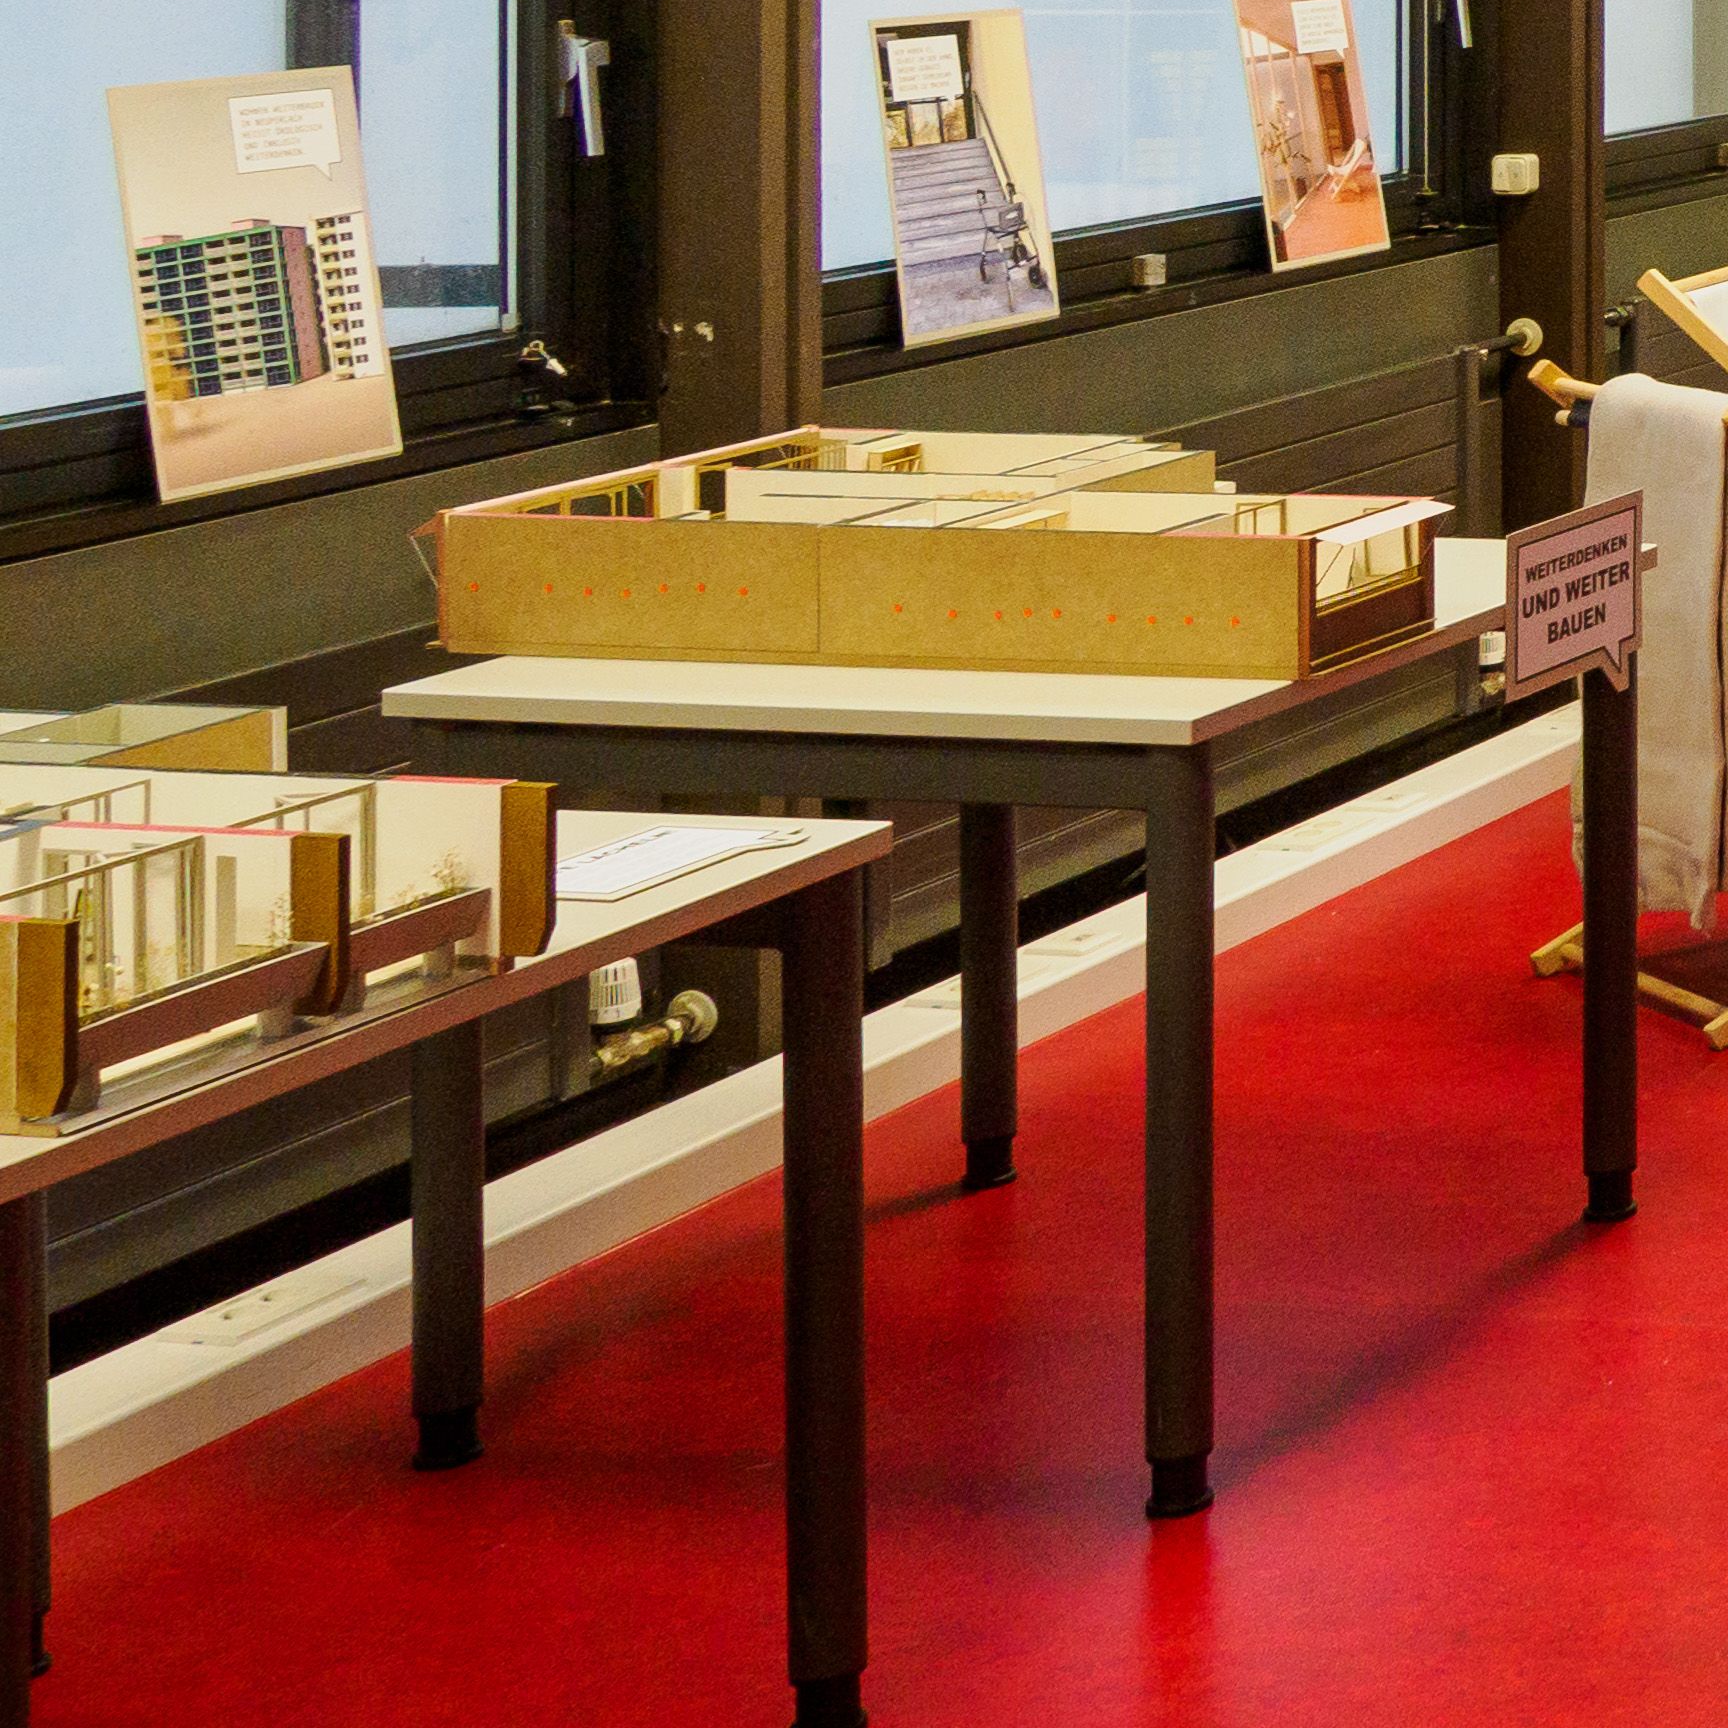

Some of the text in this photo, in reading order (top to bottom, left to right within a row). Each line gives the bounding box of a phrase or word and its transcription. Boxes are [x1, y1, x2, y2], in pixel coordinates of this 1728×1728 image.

[1525, 534, 1627, 583] WEITERDENKEN
[1522, 561, 1630, 618] UND WEITER
[1547, 603, 1606, 644] BAUEN
